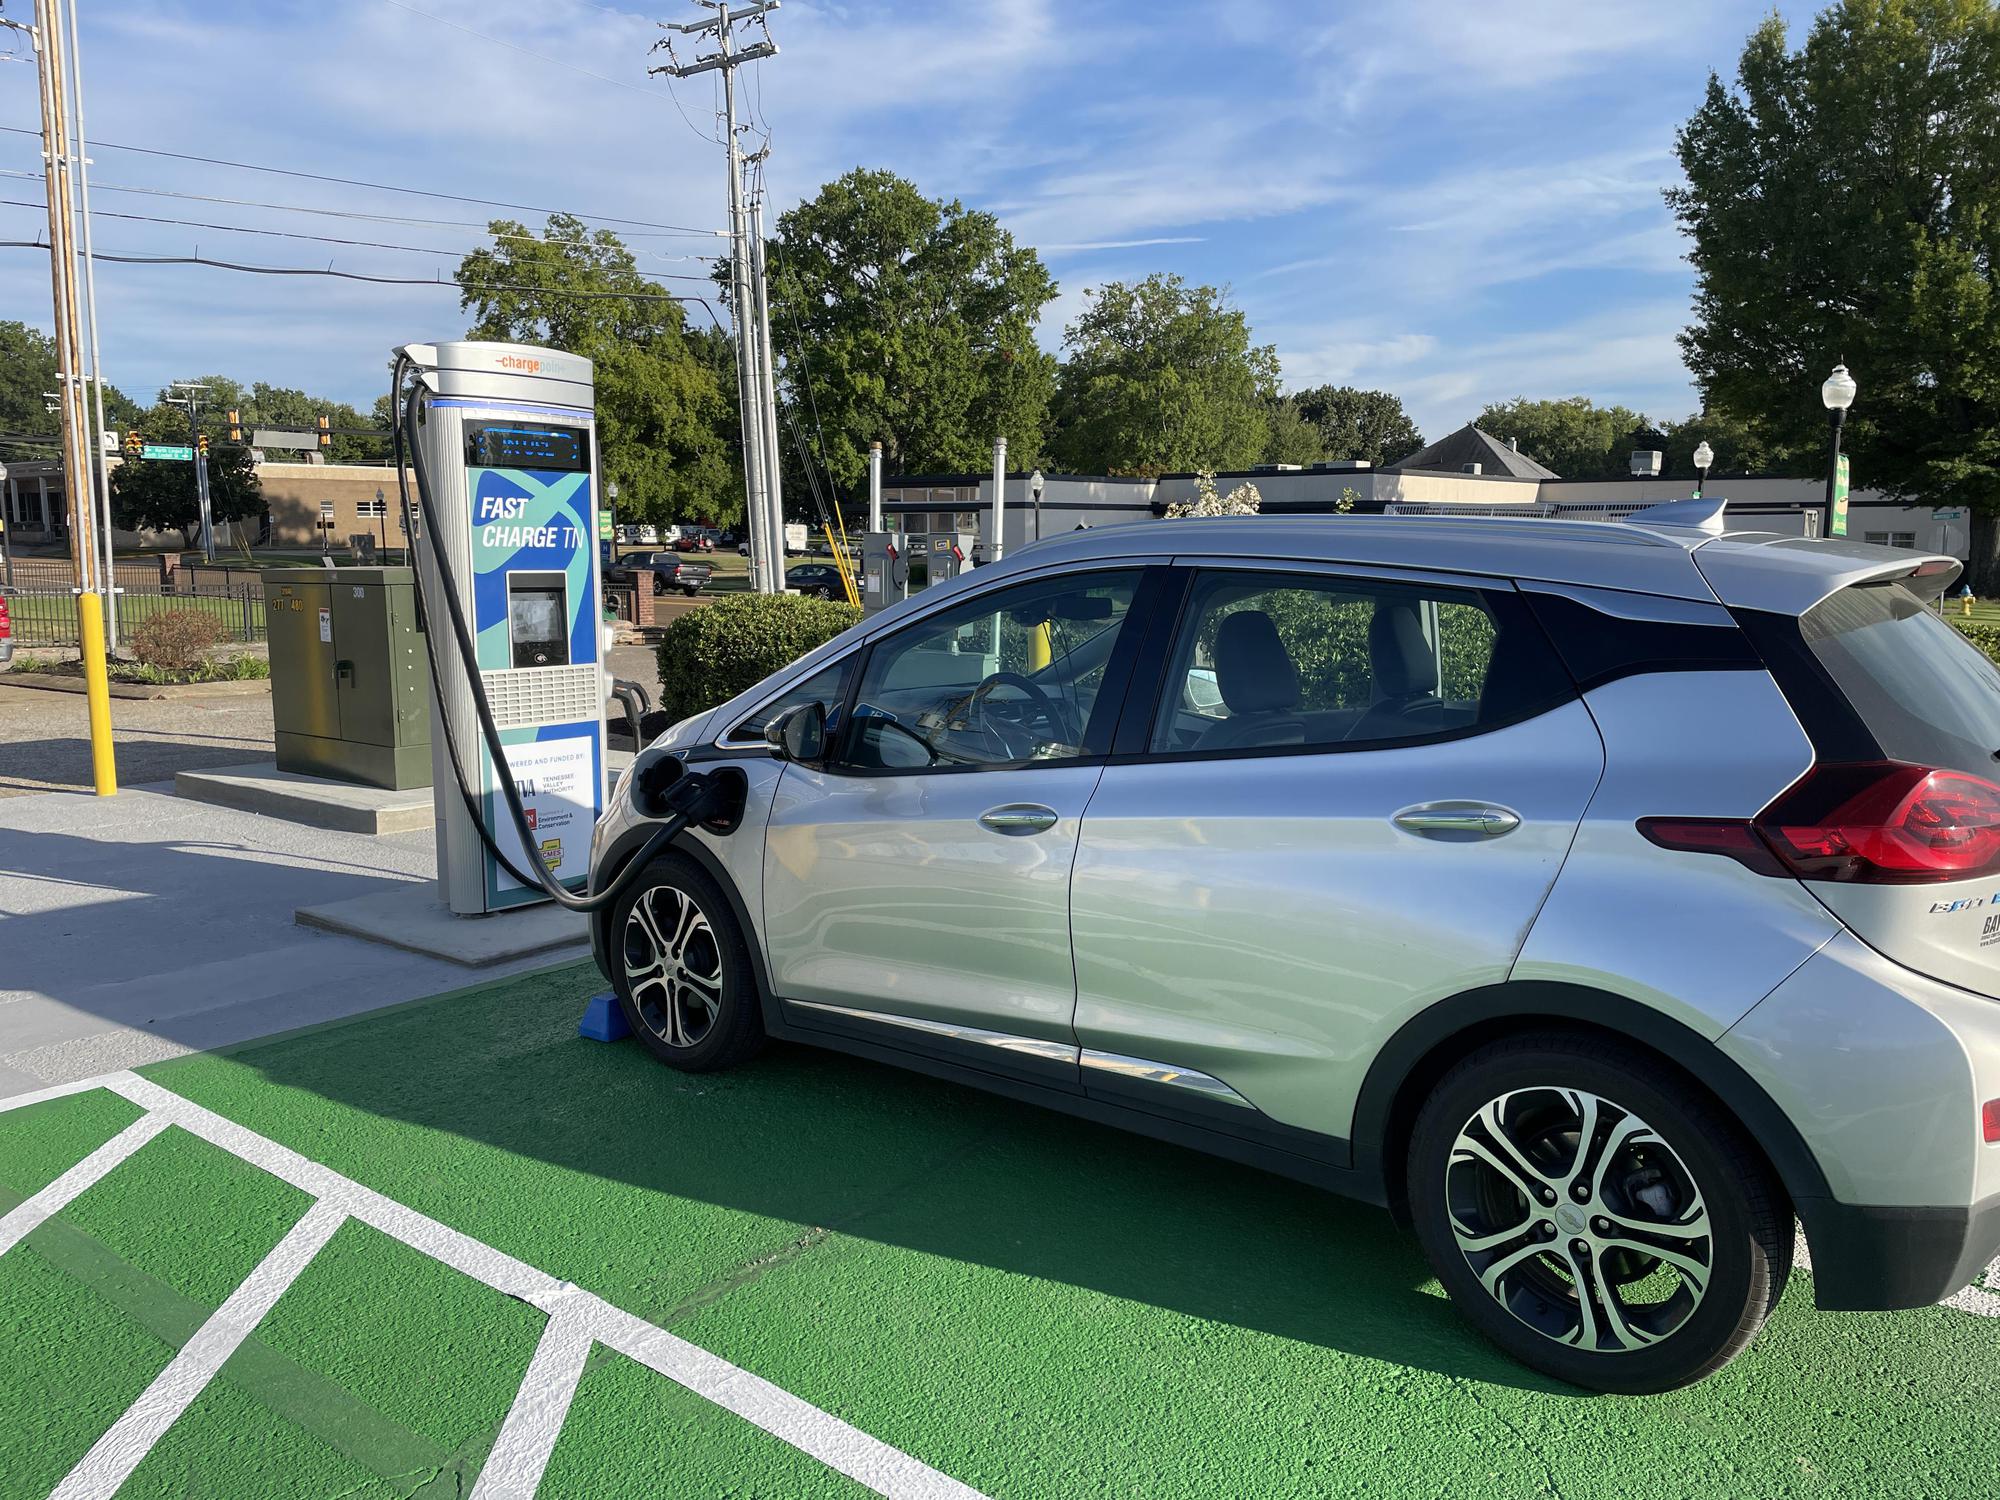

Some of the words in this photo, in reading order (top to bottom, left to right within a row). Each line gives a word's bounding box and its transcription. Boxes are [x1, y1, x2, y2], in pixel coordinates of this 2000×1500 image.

[480, 496, 529, 519] FAST
[482, 525, 558, 548] CHARGE
[562, 526, 585, 549] TN
[535, 757, 549, 765] AND
[549, 755, 575, 763] FUNDED
[543, 773, 575, 782] TENNESSEE
[514, 778, 536, 798] TVA
[543, 781, 564, 789] VALLEY
[543, 785, 575, 794] AUTHORITY
[538, 813, 568, 823] Environment
[538, 820, 570, 829] Conservation
